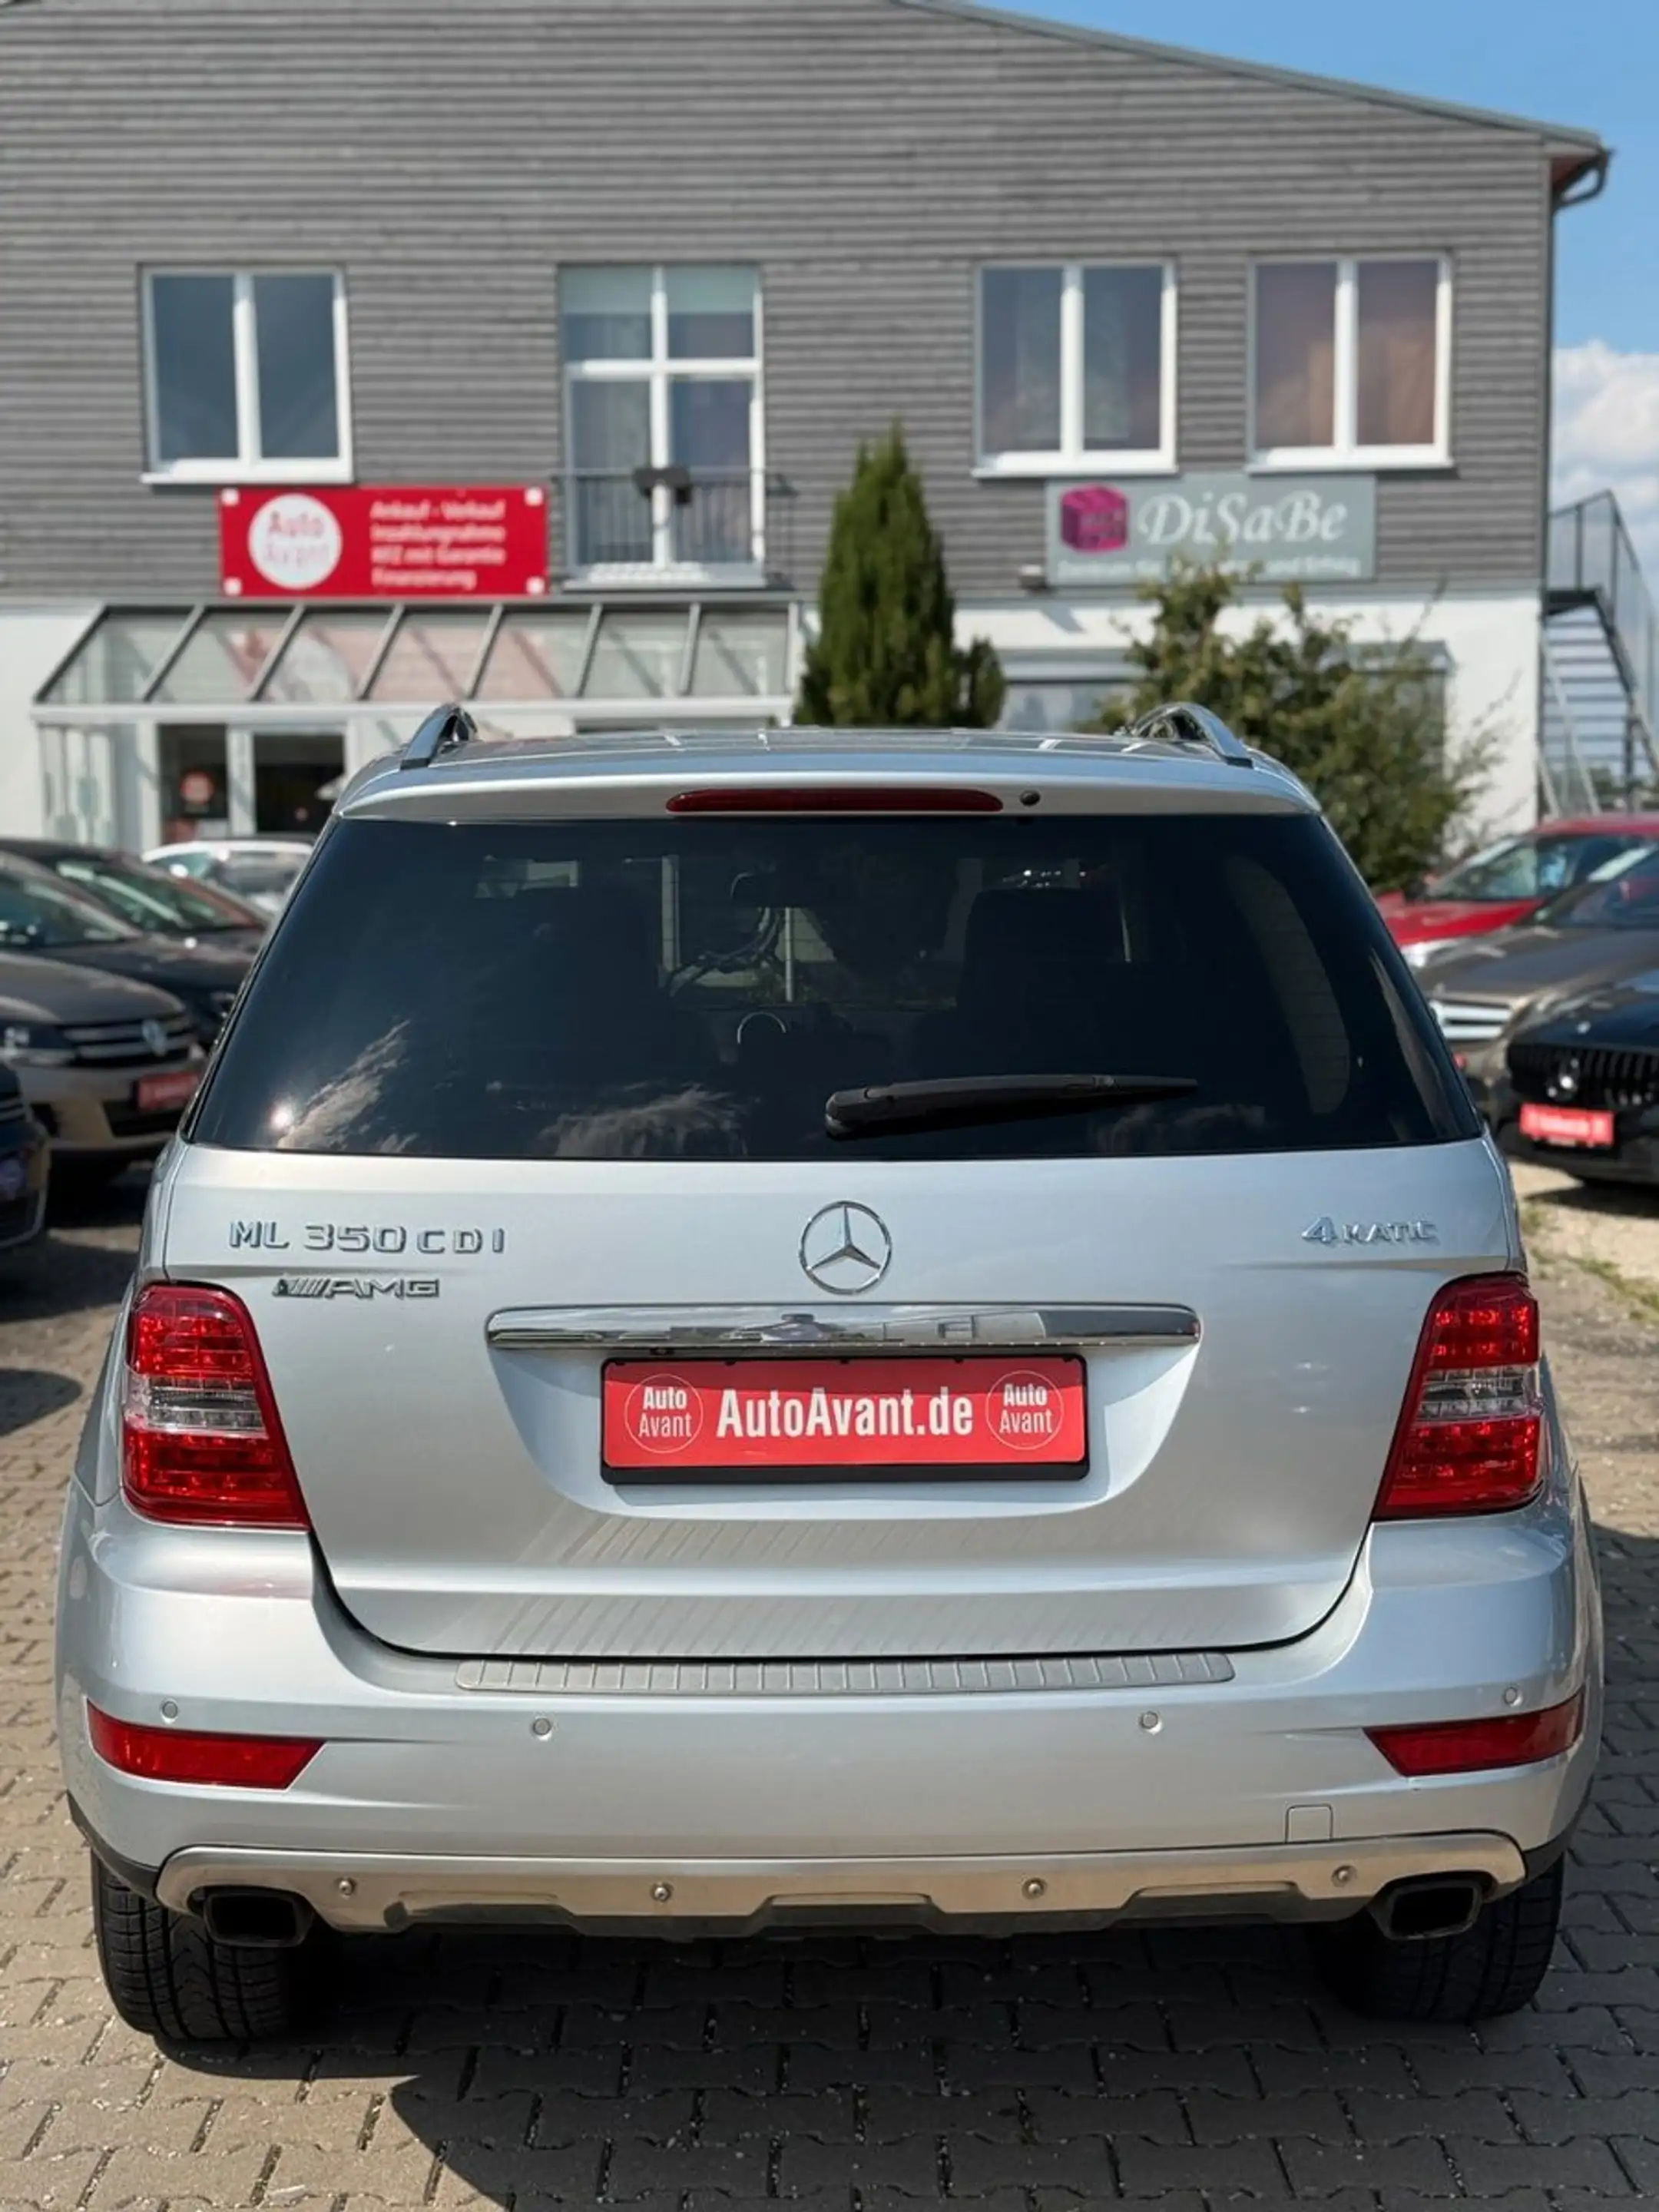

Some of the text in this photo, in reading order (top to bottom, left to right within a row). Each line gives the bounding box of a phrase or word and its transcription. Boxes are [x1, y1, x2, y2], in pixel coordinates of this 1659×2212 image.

[269, 510, 326, 538] Auto
[1138, 489, 1347, 545] DiSaBe
[230, 1220, 505, 1254] ML 350 CDI
[642, 1385, 687, 1410] Auto
[1003, 1382, 1048, 1406] Auto
[638, 1414, 692, 1438] Avant
[716, 1386, 973, 1439] AutoAvant.de
[999, 1408, 1053, 1434] Avant
